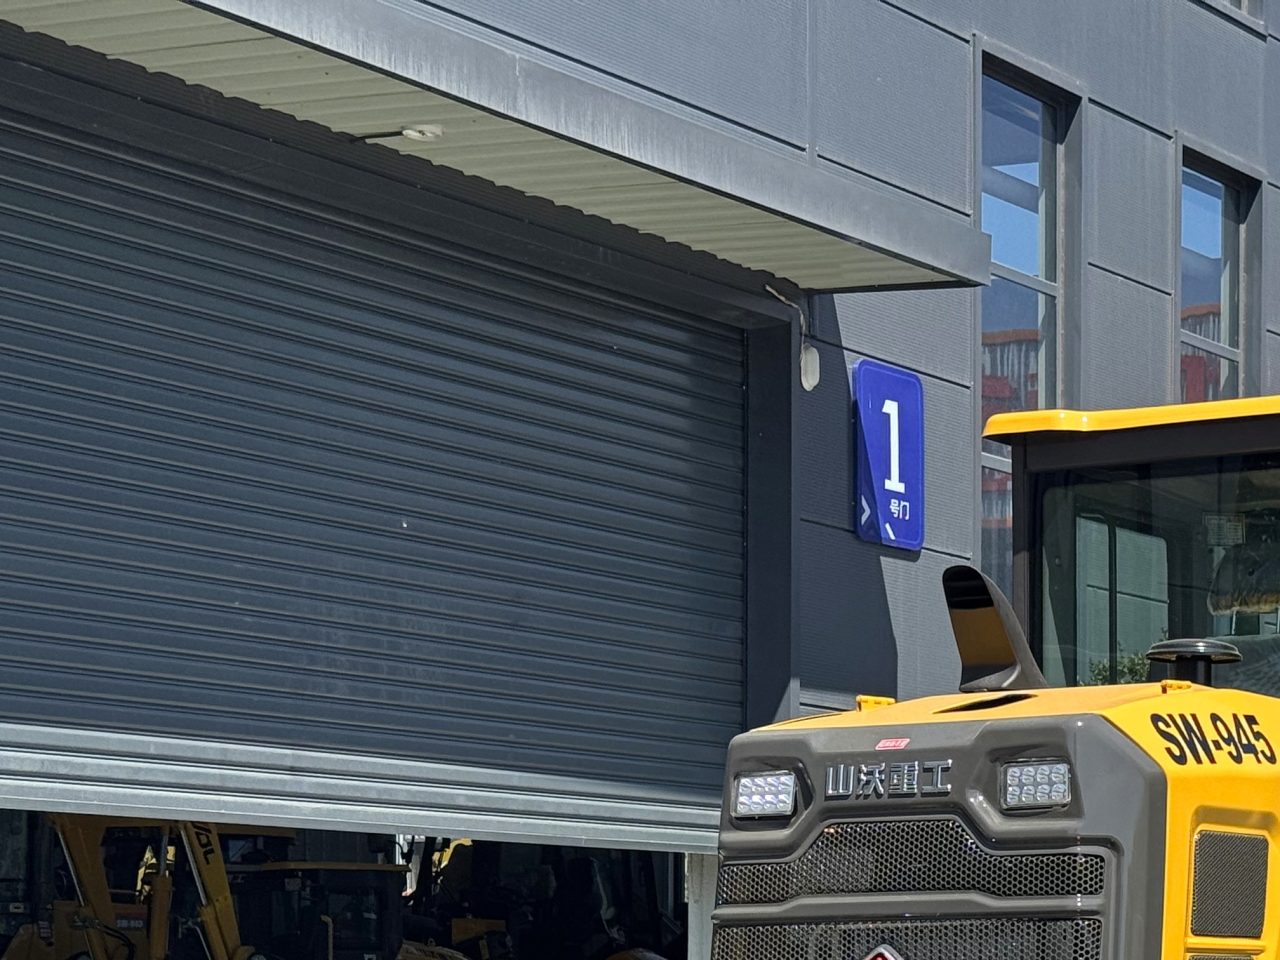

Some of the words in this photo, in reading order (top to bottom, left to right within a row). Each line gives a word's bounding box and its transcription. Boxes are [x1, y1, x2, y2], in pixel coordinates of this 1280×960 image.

[881, 399, 906, 494] 1
[889, 499, 910, 521] 号门
[1150, 712, 1278, 766] SW-945
[825, 758, 954, 800] 山沃重工
